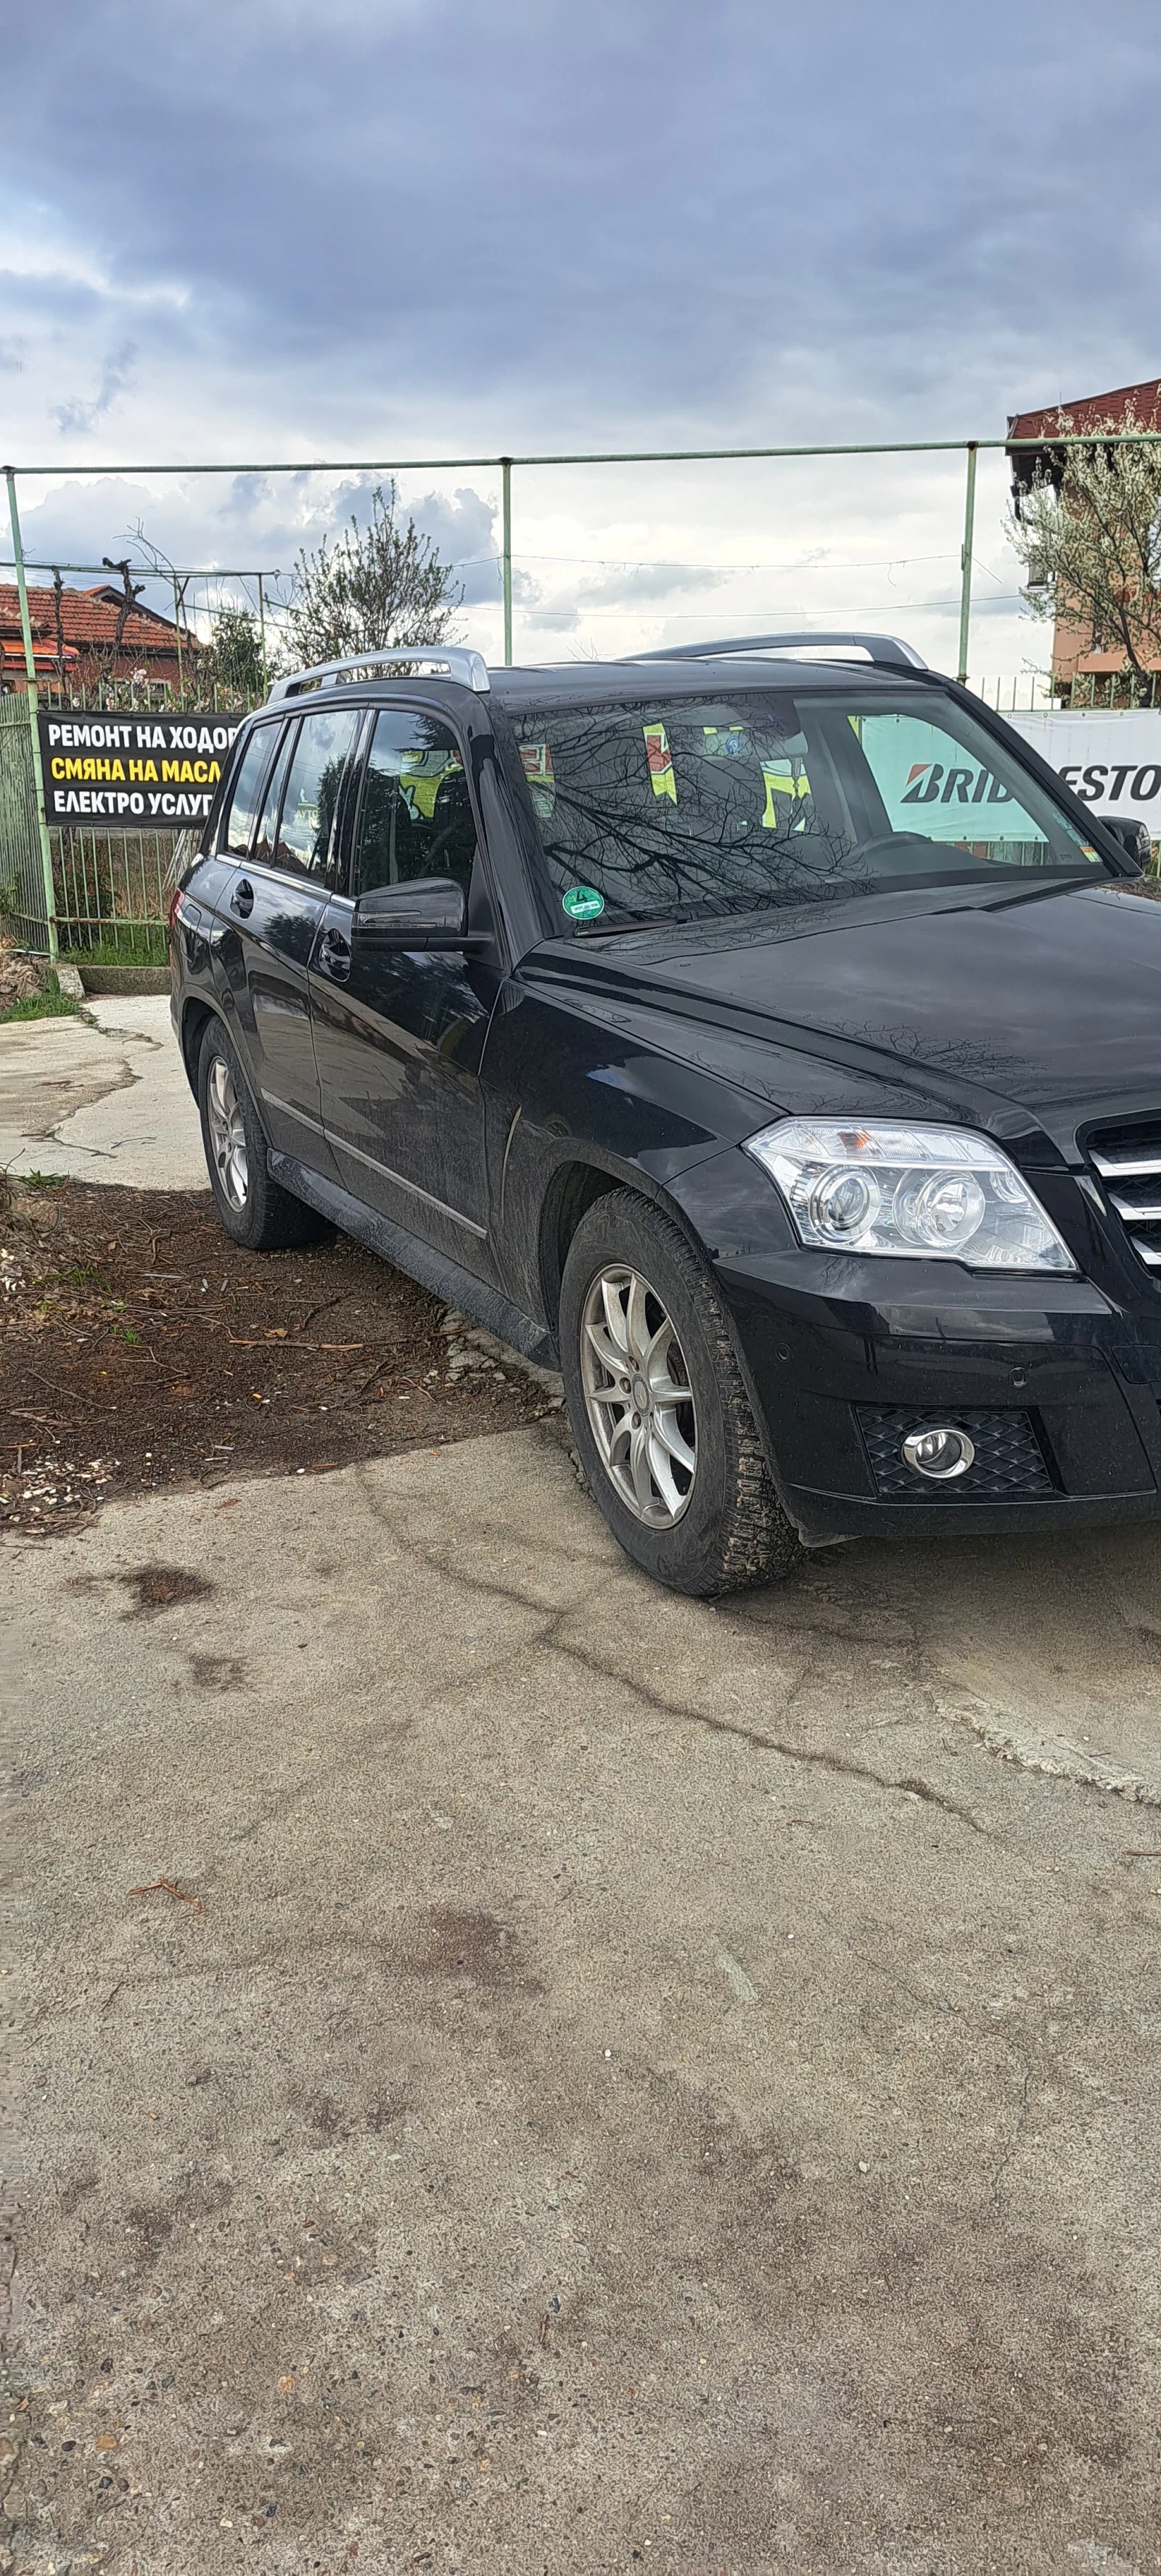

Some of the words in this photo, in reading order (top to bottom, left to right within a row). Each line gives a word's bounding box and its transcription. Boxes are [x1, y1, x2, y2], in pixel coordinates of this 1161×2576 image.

[48, 723, 132, 748] РЕМОНТ
[136, 726, 166, 749] НА
[52, 758, 126, 782] СМЯНА
[129, 760, 158, 782] НА
[162, 760, 221, 783] МАСЛ
[54, 790, 144, 814] ЕЛЕКТРО
[147, 792, 213, 816] УСЛУГ
[577, 889, 588, 902] 4
